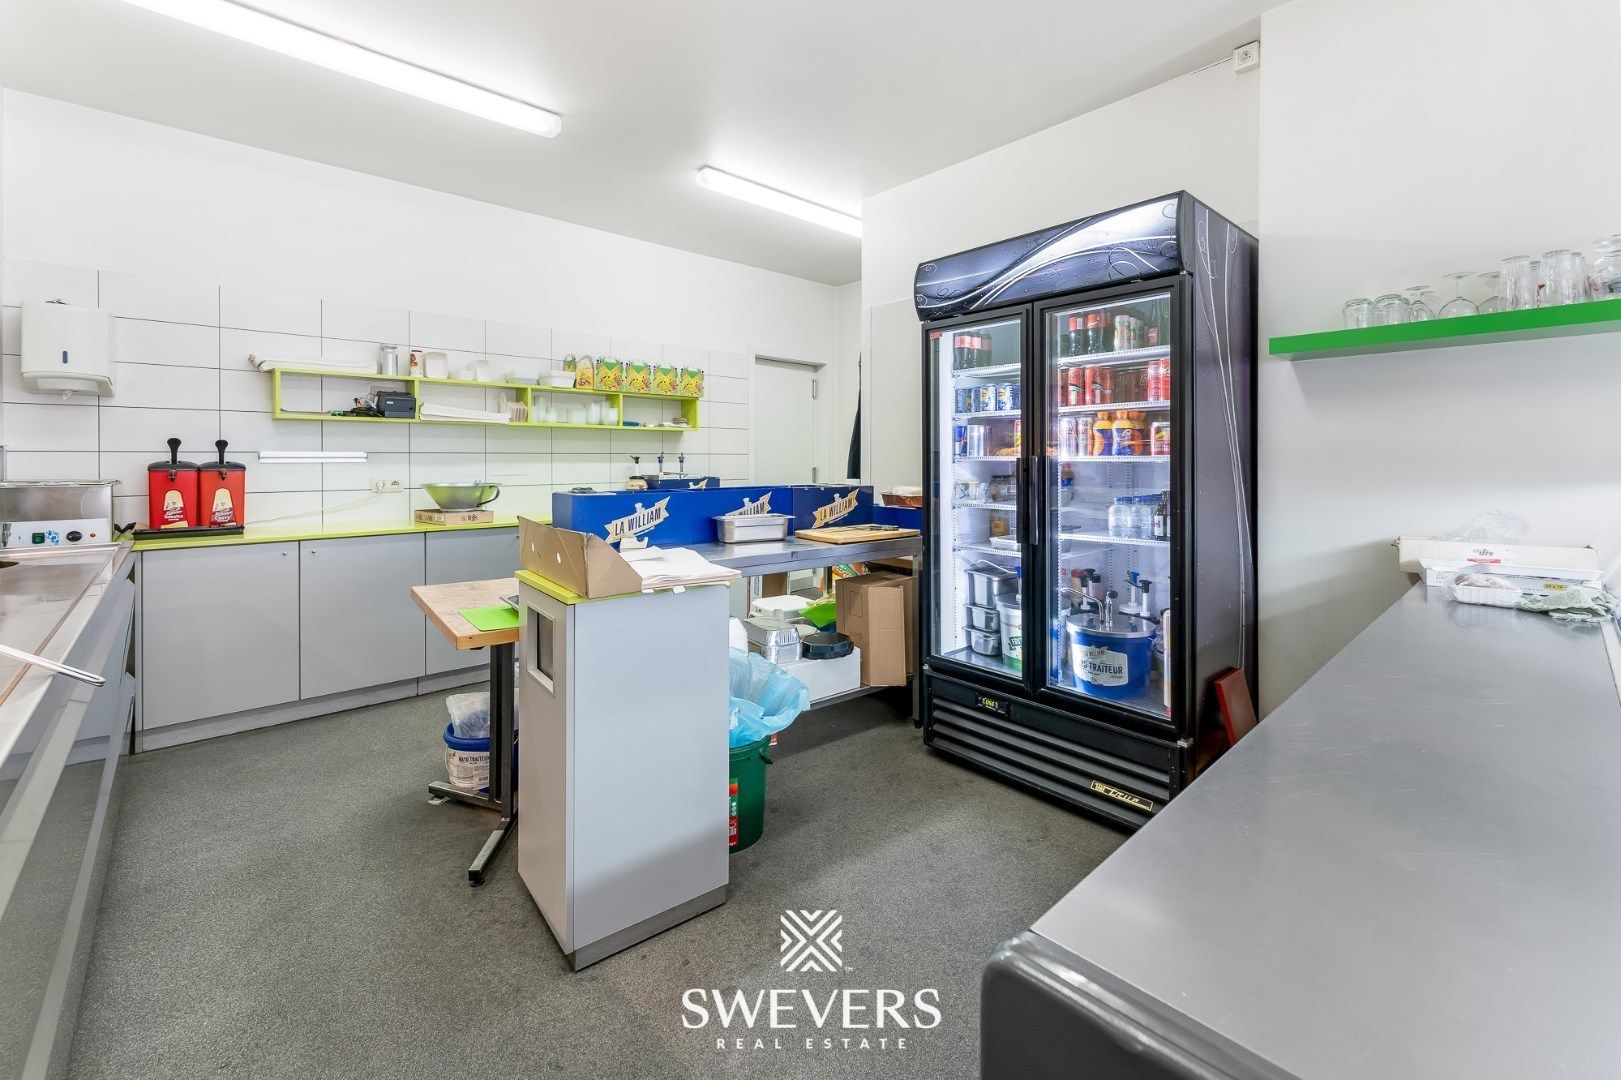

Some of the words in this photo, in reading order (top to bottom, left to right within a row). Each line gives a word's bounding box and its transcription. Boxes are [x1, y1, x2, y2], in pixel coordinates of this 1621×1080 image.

[820, 510, 828, 521] LA
[829, 496, 853, 517] WILLIAM
[615, 521, 625, 536] LA
[628, 507, 661, 532] WILLIAM
[1089, 663, 1123, 675] TRAITEUR
